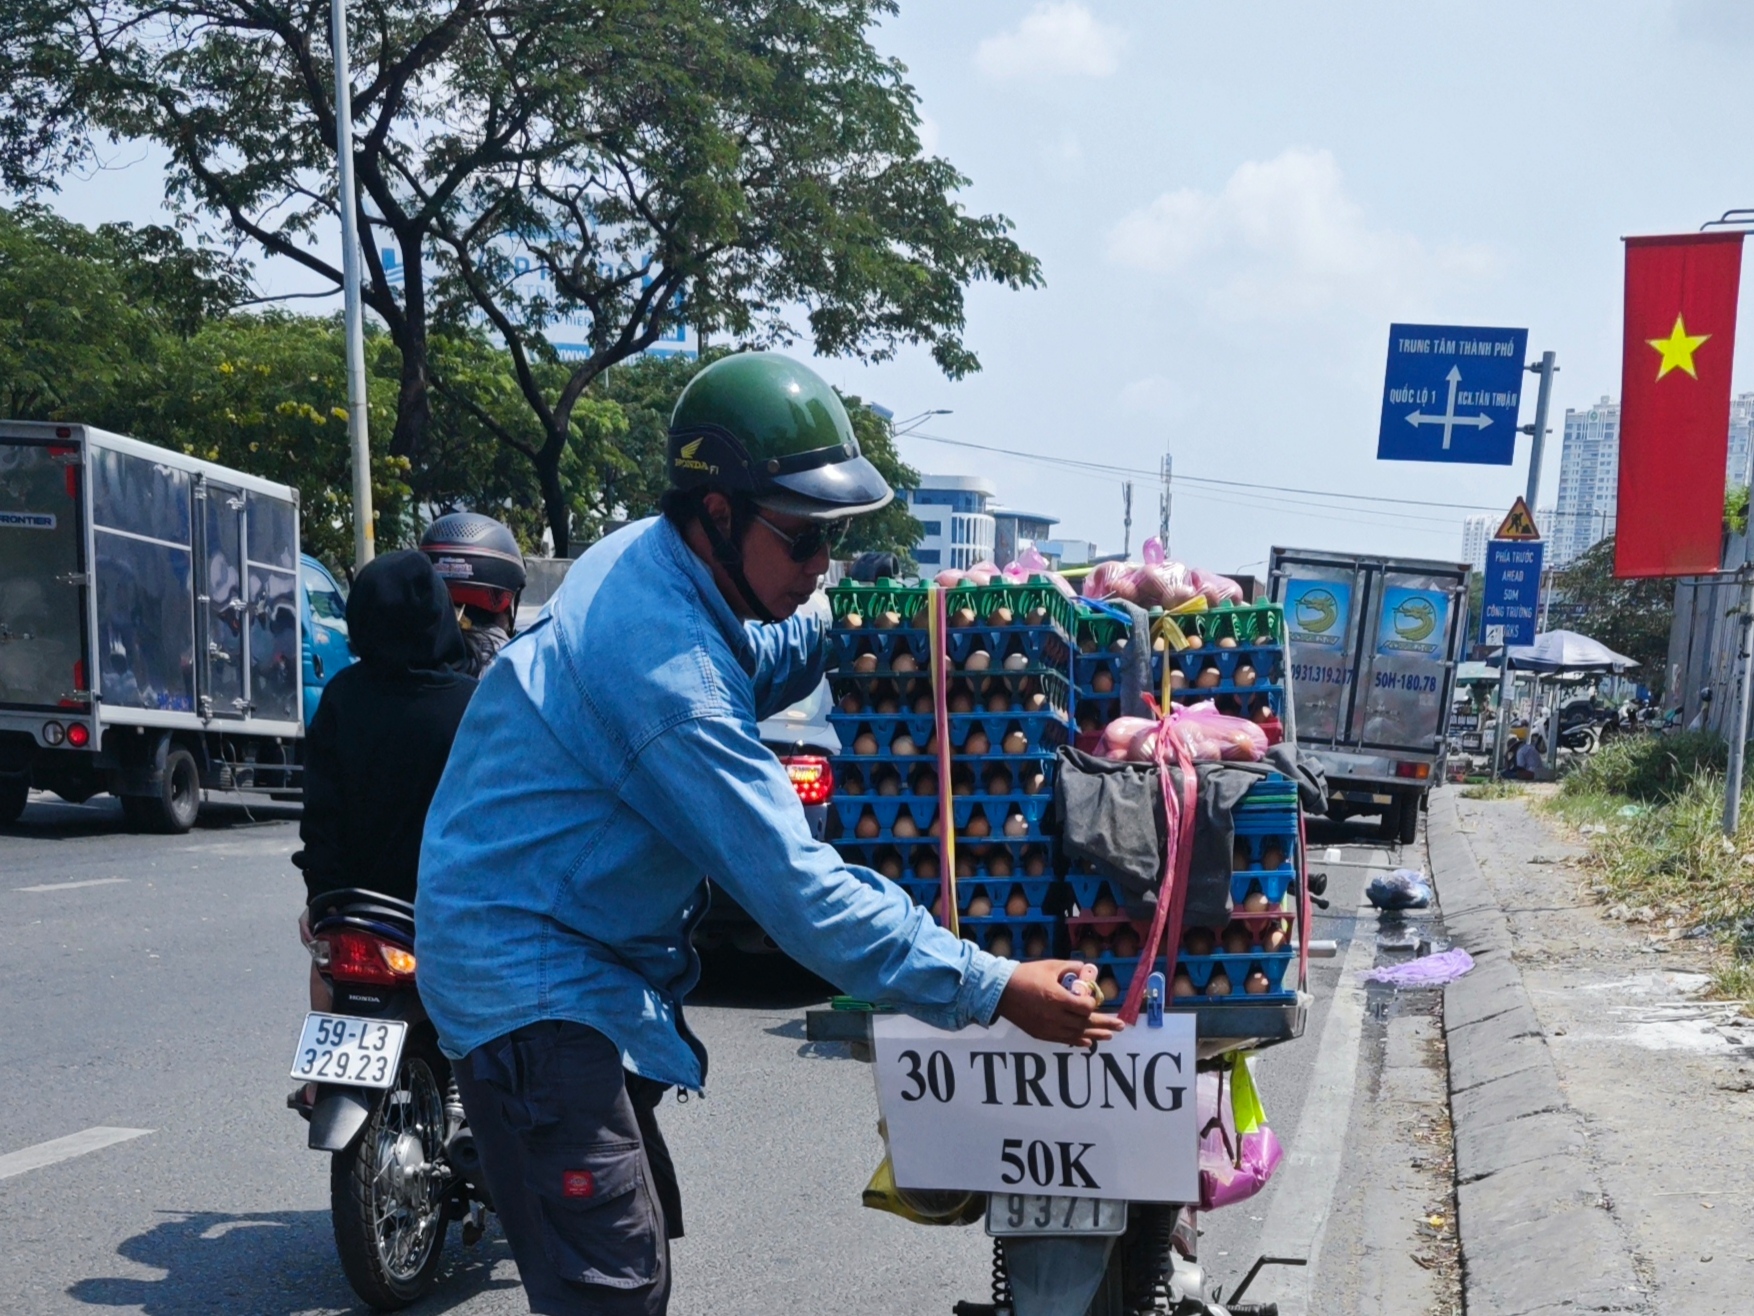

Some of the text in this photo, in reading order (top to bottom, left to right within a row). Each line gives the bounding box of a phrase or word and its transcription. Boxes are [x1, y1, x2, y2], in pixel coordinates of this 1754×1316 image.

[1399, 337, 1515, 357] TRUNG TÂM THÀNH PHỐ
[1389, 384, 1436, 407] QUỐC LỘ 1
[1492, 390, 1517, 410] THUẬN
[675, 458, 709, 470] HONDA
[1495, 549, 1534, 563] PHÍA TRƯỚC
[1502, 570, 1524, 583] AHEAD
[1503, 589, 1519, 601] 50M
[1486, 604, 1533, 618] CÔNG TRƯỜNG
[1374, 671, 1437, 692] 50H-180.78
[349, 994, 380, 1003] HONDA
[316, 1018, 389, 1051] 59-L3
[301, 1048, 388, 1082] 329.23
[897, 1049, 955, 1103] 30
[1001, 1138, 1100, 1189] 50K
